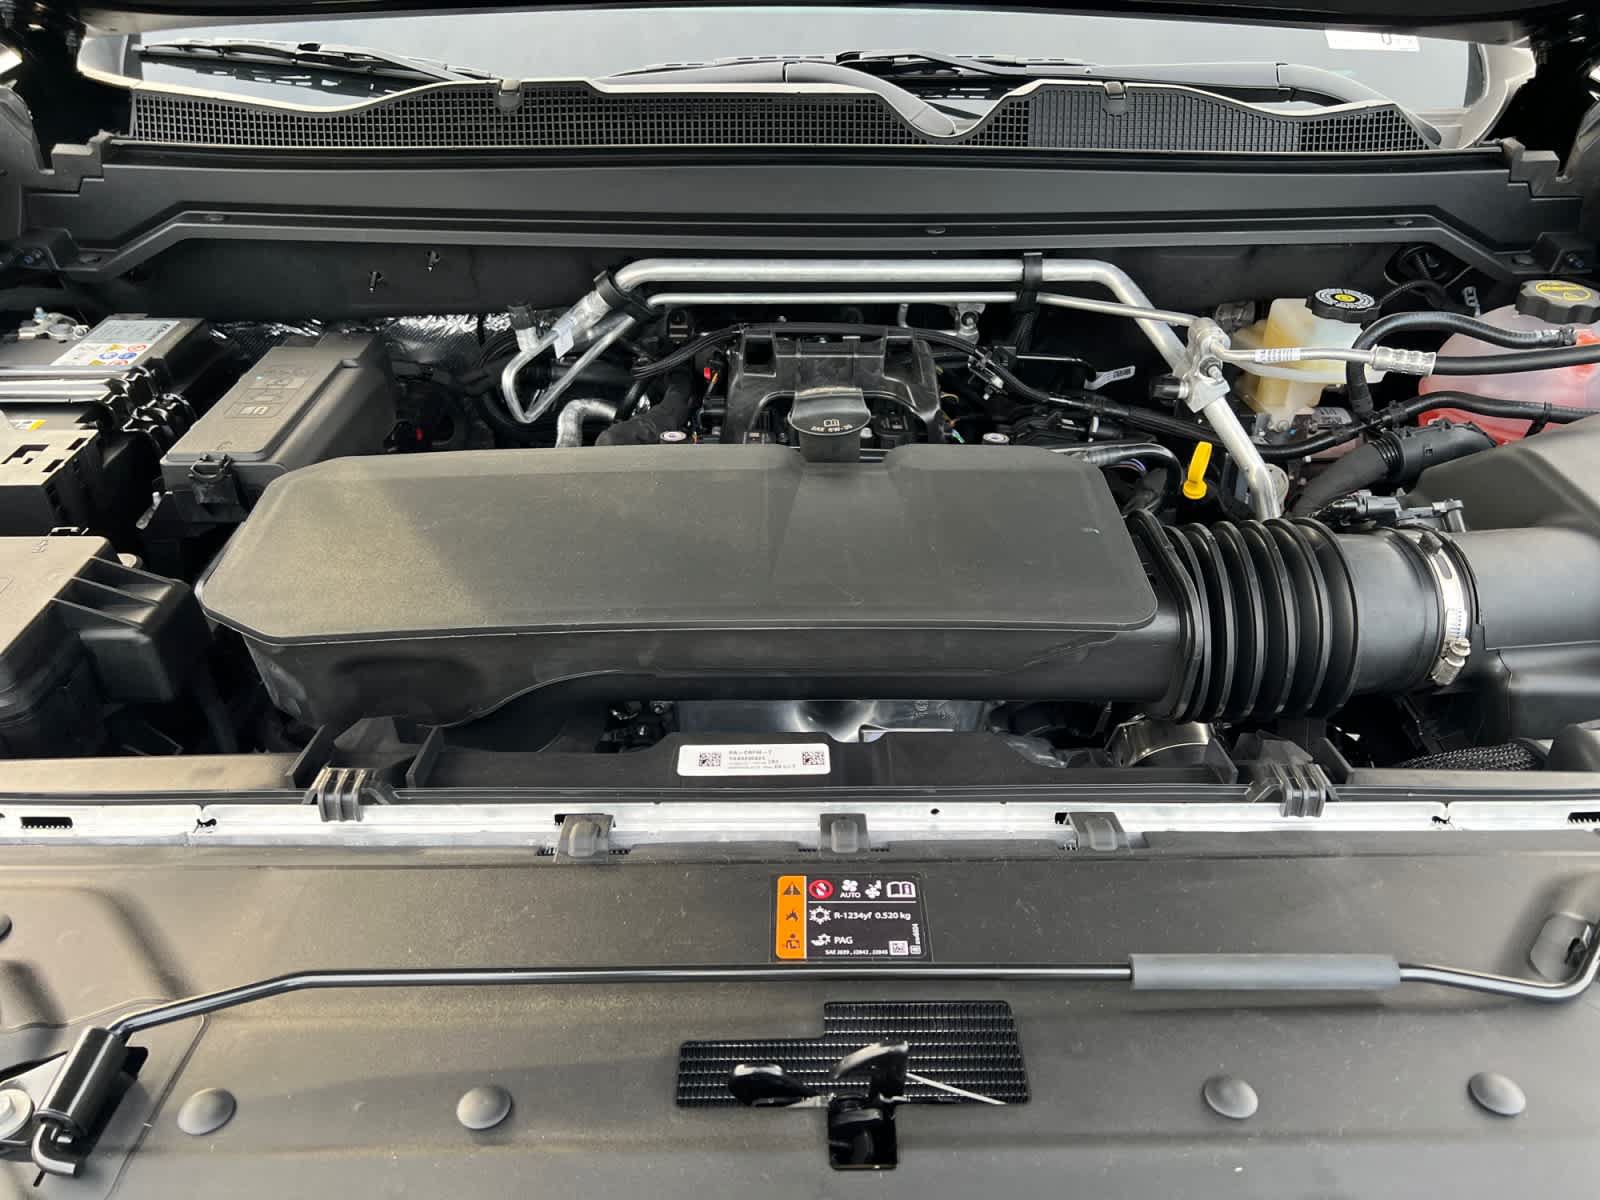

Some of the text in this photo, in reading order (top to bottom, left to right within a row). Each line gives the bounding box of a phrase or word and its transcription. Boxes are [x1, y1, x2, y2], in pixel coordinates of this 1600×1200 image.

[840, 891, 861, 899] AUTO
[834, 912, 911, 921] R-1234yf 0.520 kg
[834, 936, 853, 945] PAG
